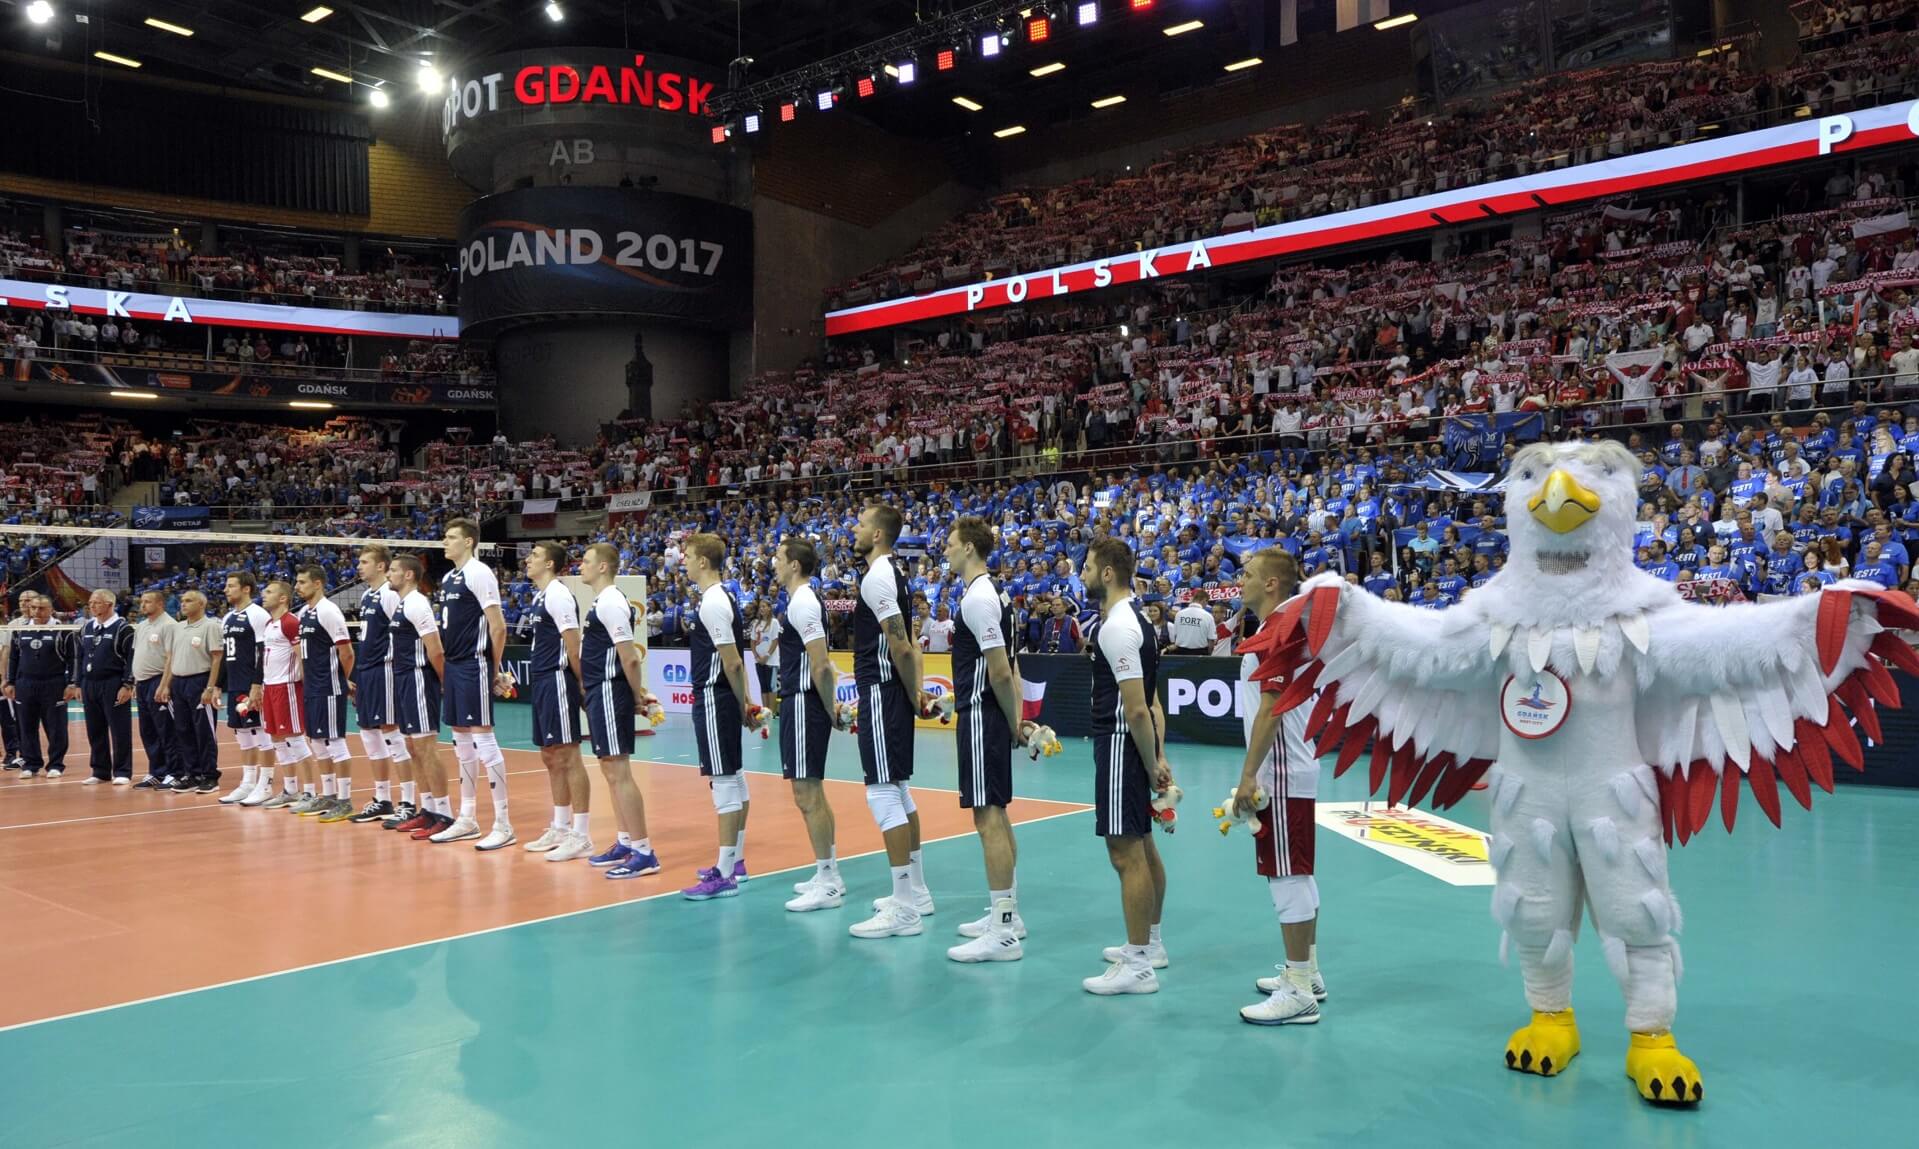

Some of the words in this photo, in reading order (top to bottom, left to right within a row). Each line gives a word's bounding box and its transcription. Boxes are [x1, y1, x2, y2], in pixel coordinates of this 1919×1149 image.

[443, 73, 503, 144] OPOT
[514, 54, 714, 117] GDAŃSK
[549, 139, 595, 167] AB
[459, 228, 603, 283] POLAND
[615, 231, 724, 276] 2017
[966, 241, 1212, 311] POLSKA
[297, 383, 348, 396] GDAŃSK
[447, 388, 494, 400] GDAŃSK
[1179, 616, 1203, 626] FORT
[663, 664, 693, 683] GD
[672, 692, 696, 705] HOS
